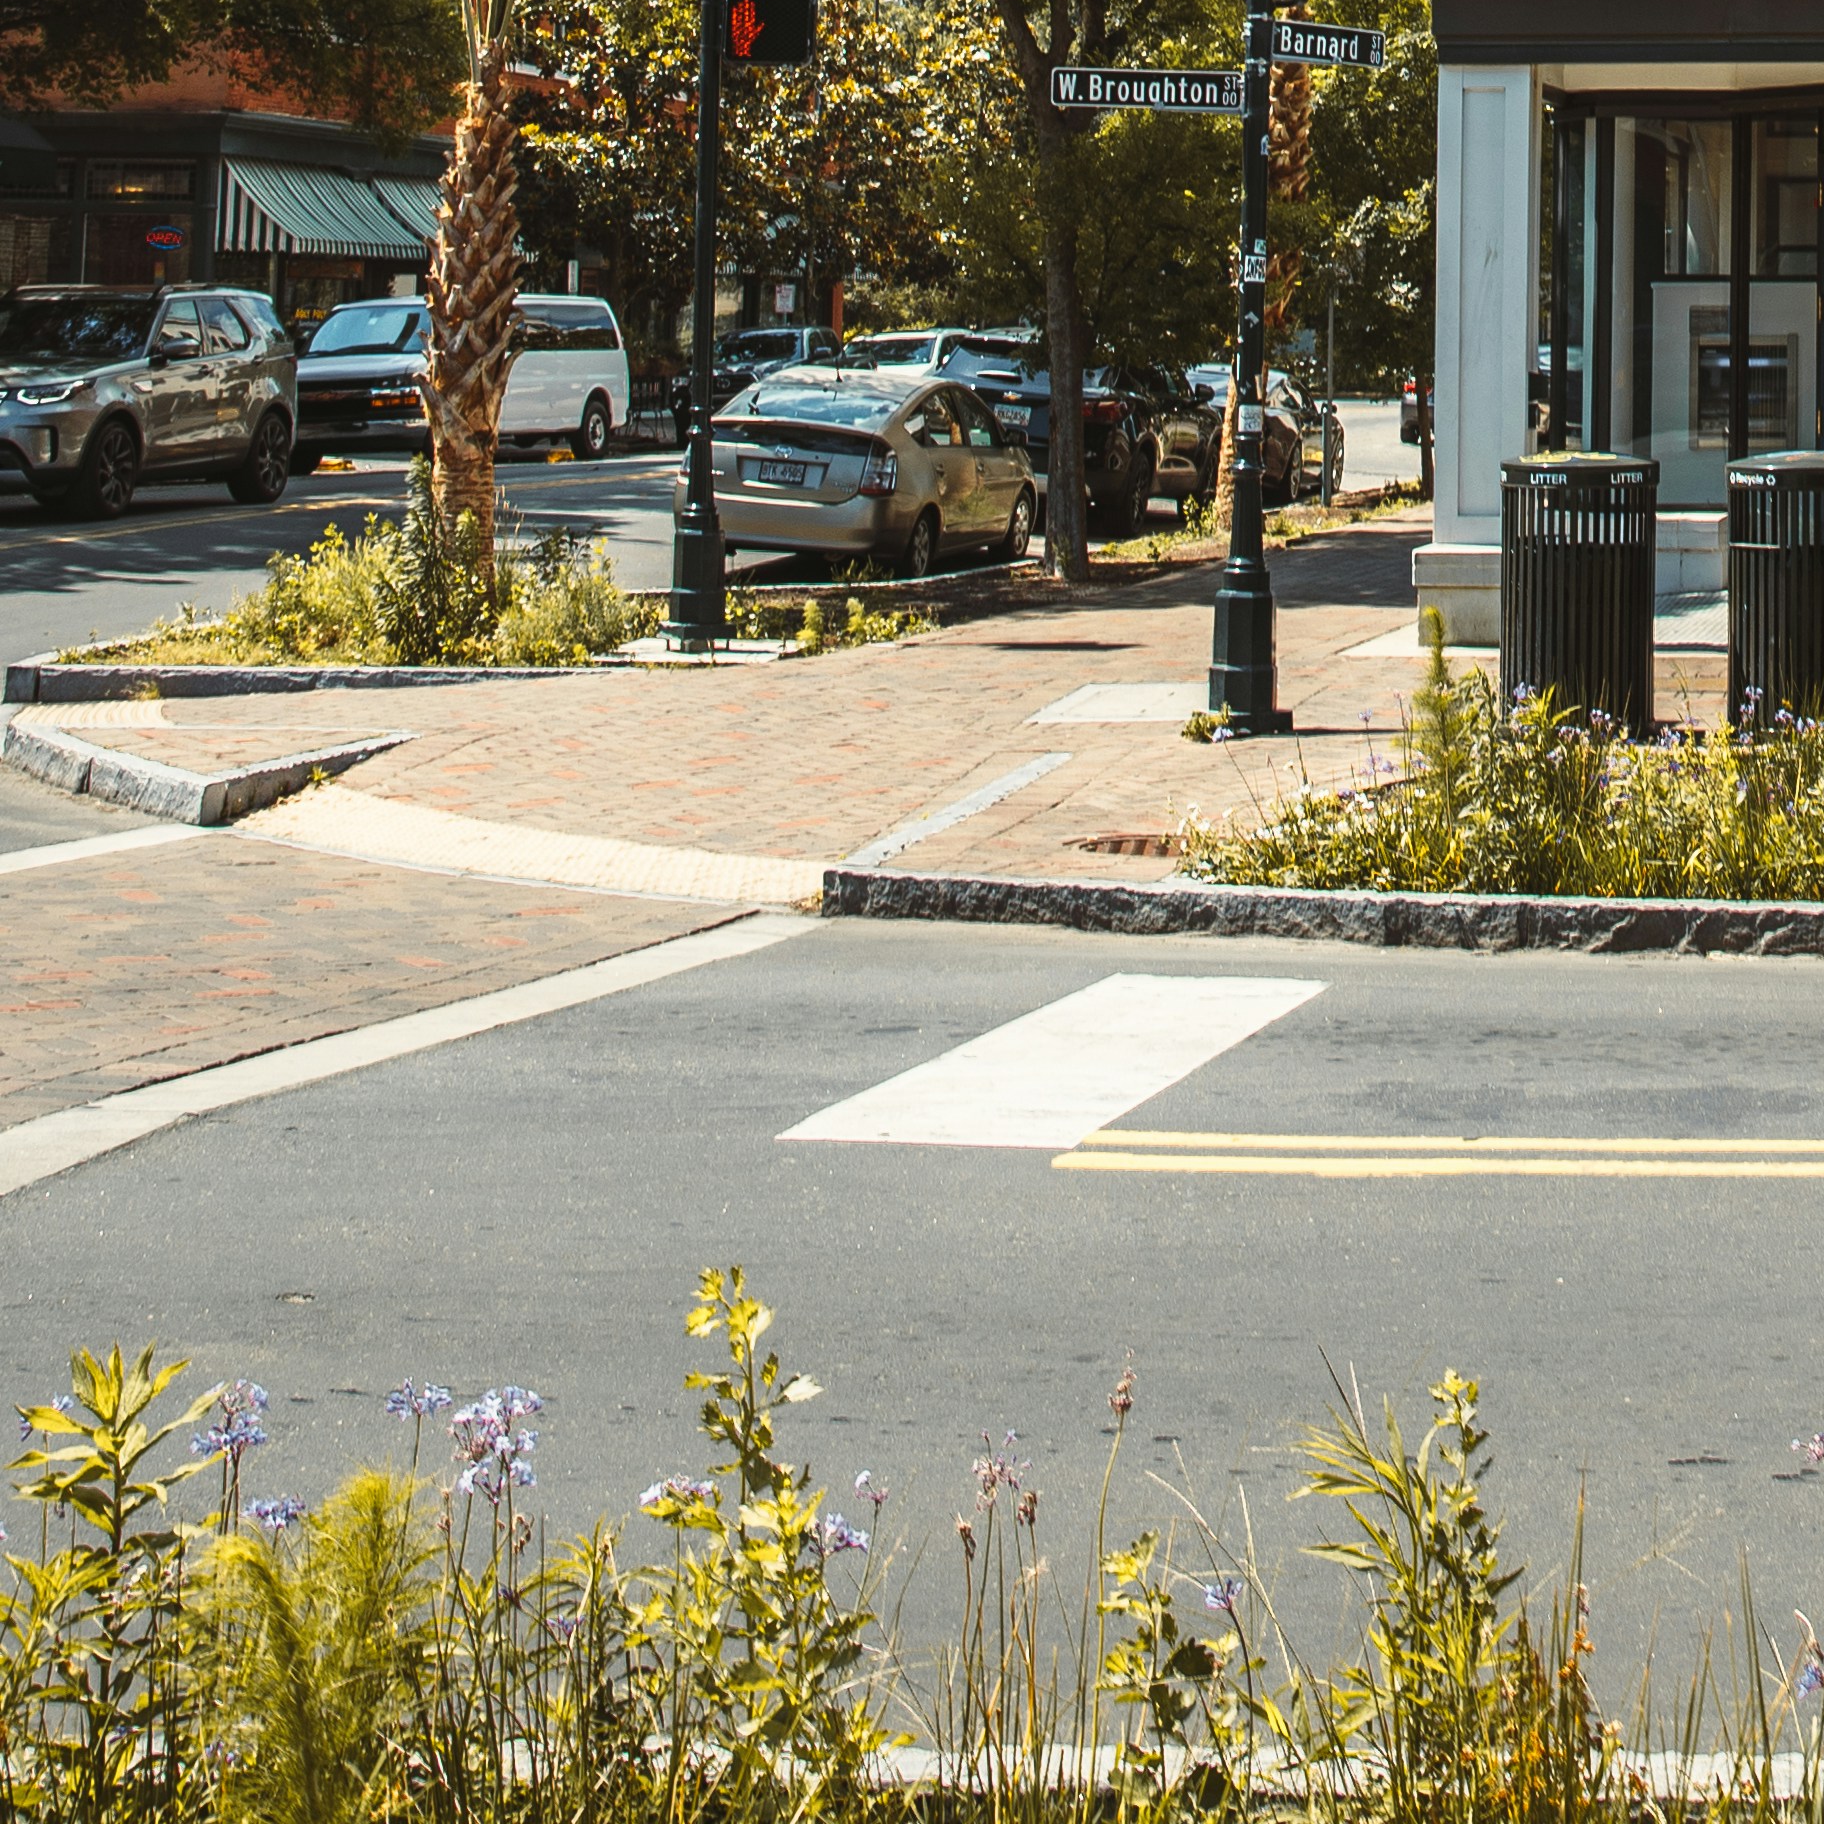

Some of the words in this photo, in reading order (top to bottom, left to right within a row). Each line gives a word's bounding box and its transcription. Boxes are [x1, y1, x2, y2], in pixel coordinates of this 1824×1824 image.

[1280, 25, 1359, 60] Barnard
[1371, 35, 1381, 49] ST
[1089, 74, 1218, 104] Broughton
[1223, 76, 1238, 91] ST
[146, 231, 182, 244] OPEN
[1530, 472, 1568, 485] LITTER
[1611, 471, 1643, 484] LITTER
[1736, 472, 1765, 486] Recycle
